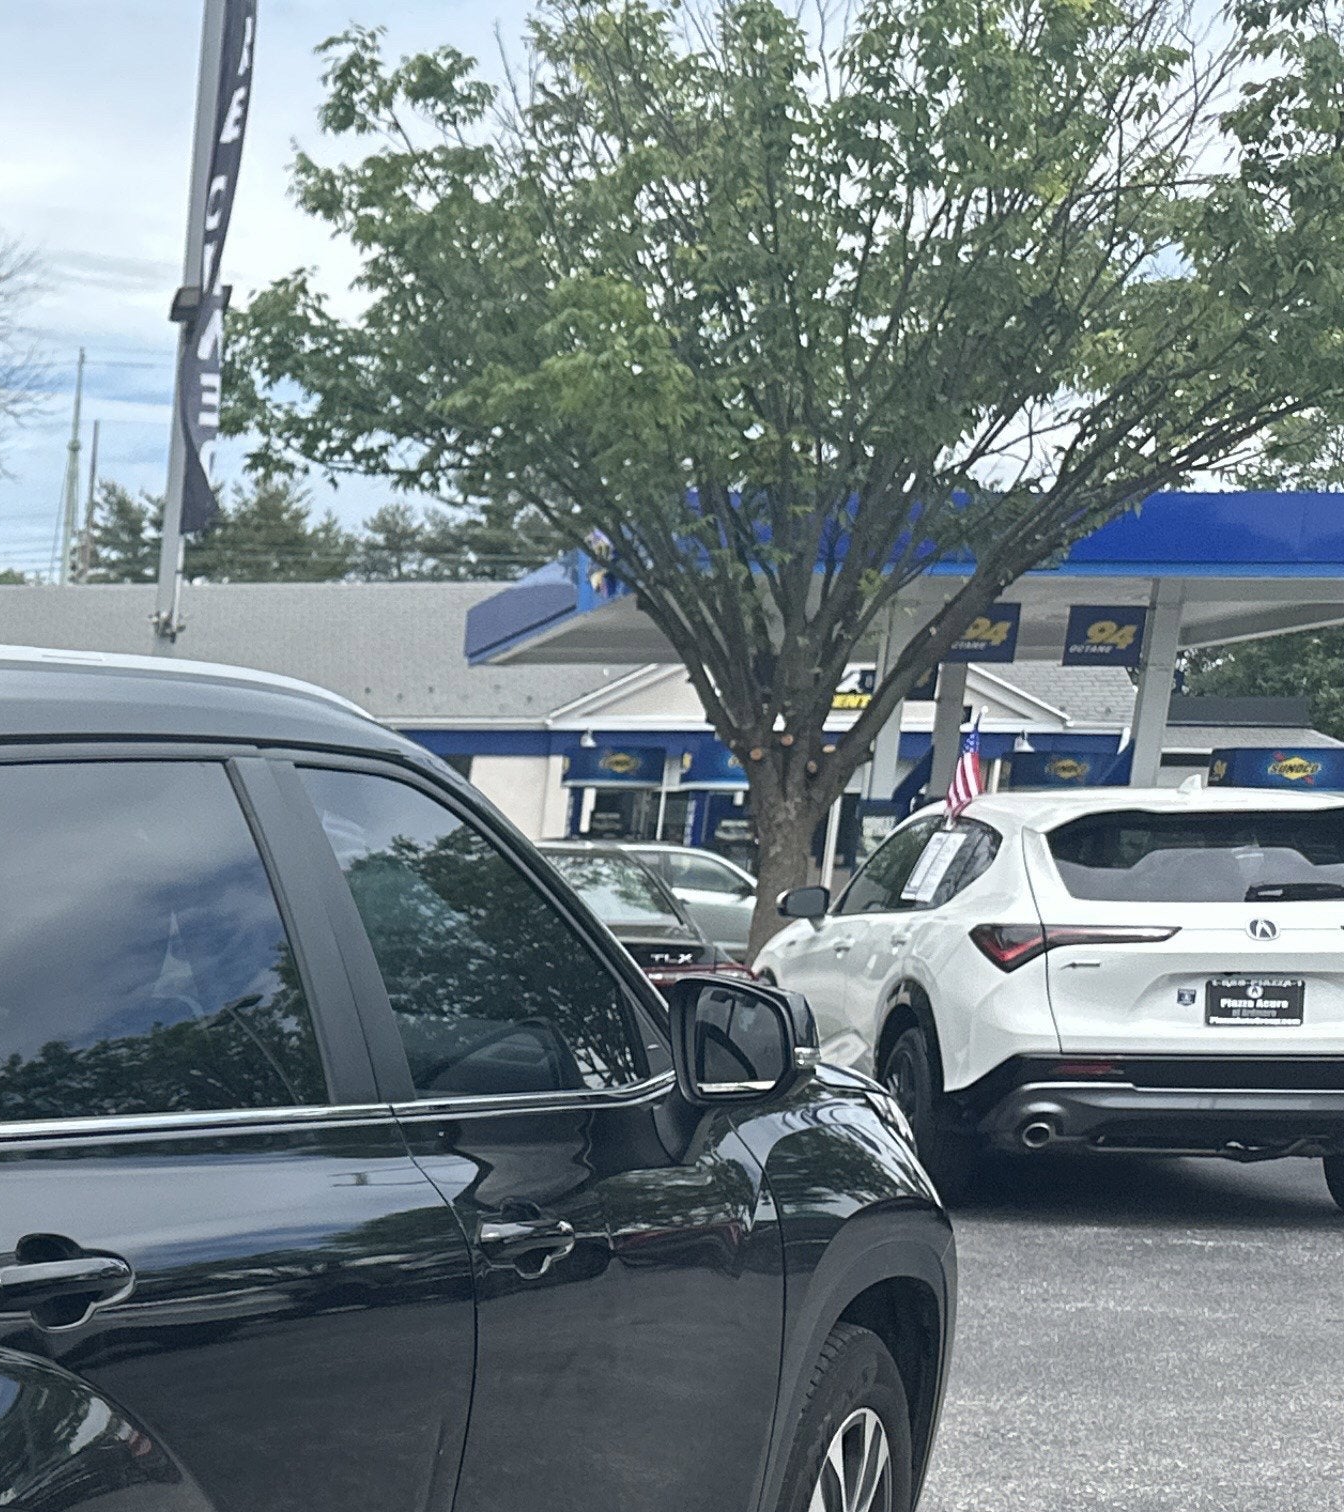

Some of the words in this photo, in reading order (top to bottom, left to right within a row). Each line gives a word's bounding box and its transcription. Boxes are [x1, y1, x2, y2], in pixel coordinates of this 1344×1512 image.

[1086, 620, 1138, 650] 94
[1068, 643, 1113, 653] OCTANE
[650, 953, 694, 964] TLX
